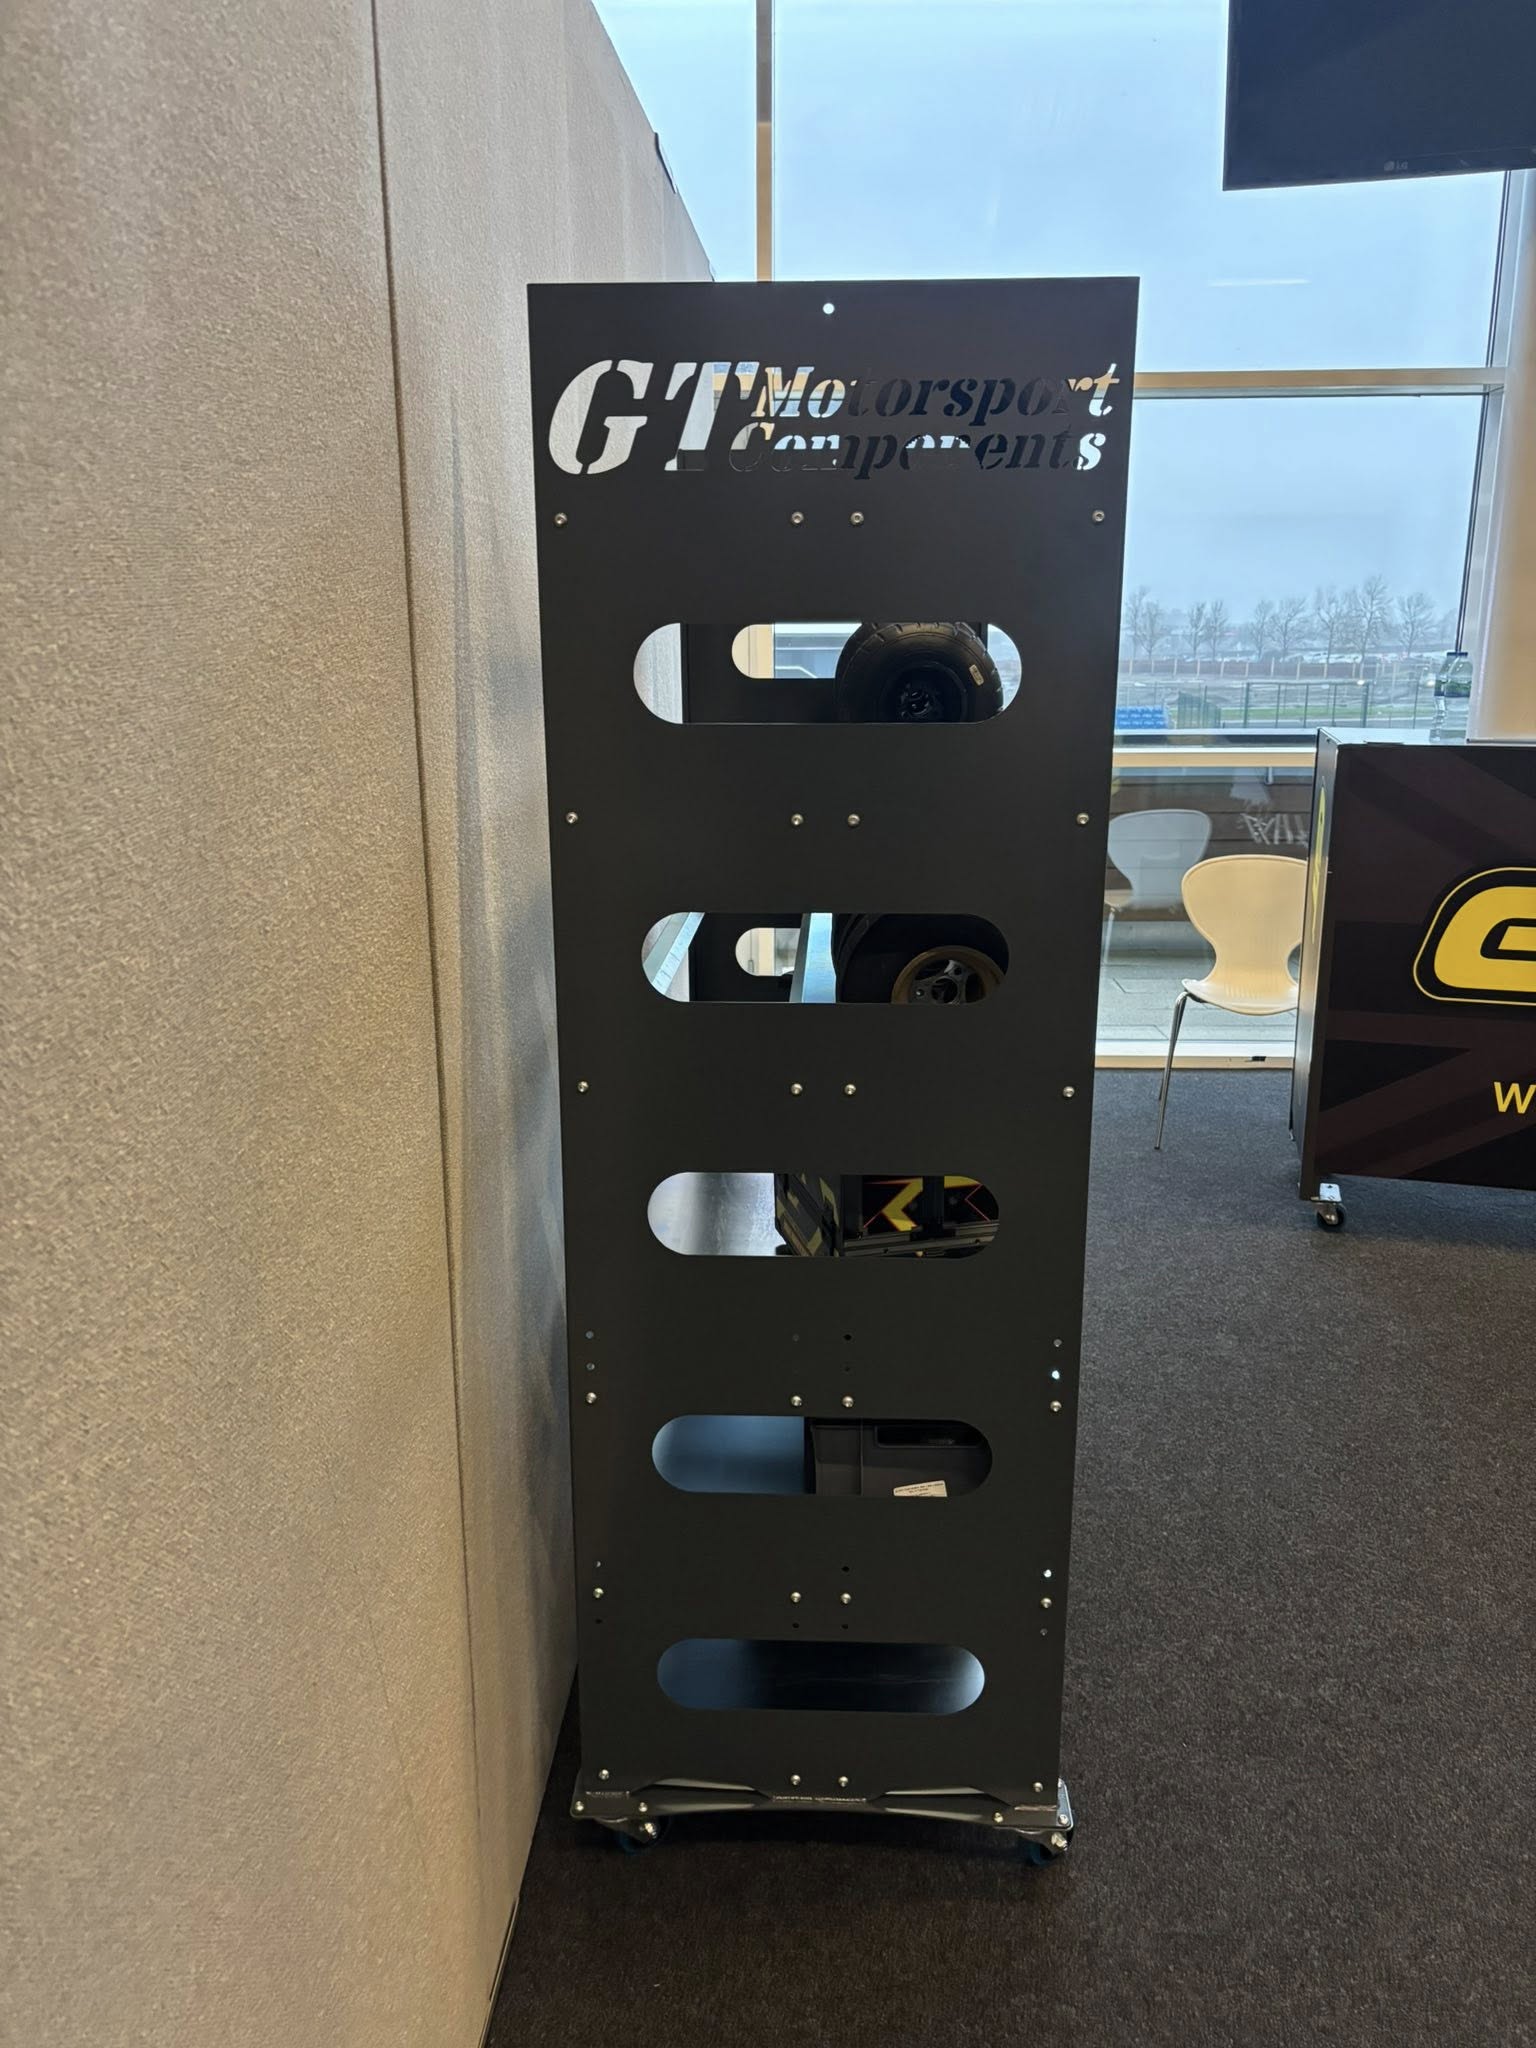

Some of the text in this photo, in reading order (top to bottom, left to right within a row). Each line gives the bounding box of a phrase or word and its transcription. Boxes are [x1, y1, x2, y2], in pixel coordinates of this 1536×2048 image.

[549, 360, 1120, 474] GT Motorsport
[729, 422, 1106, 479] Components
